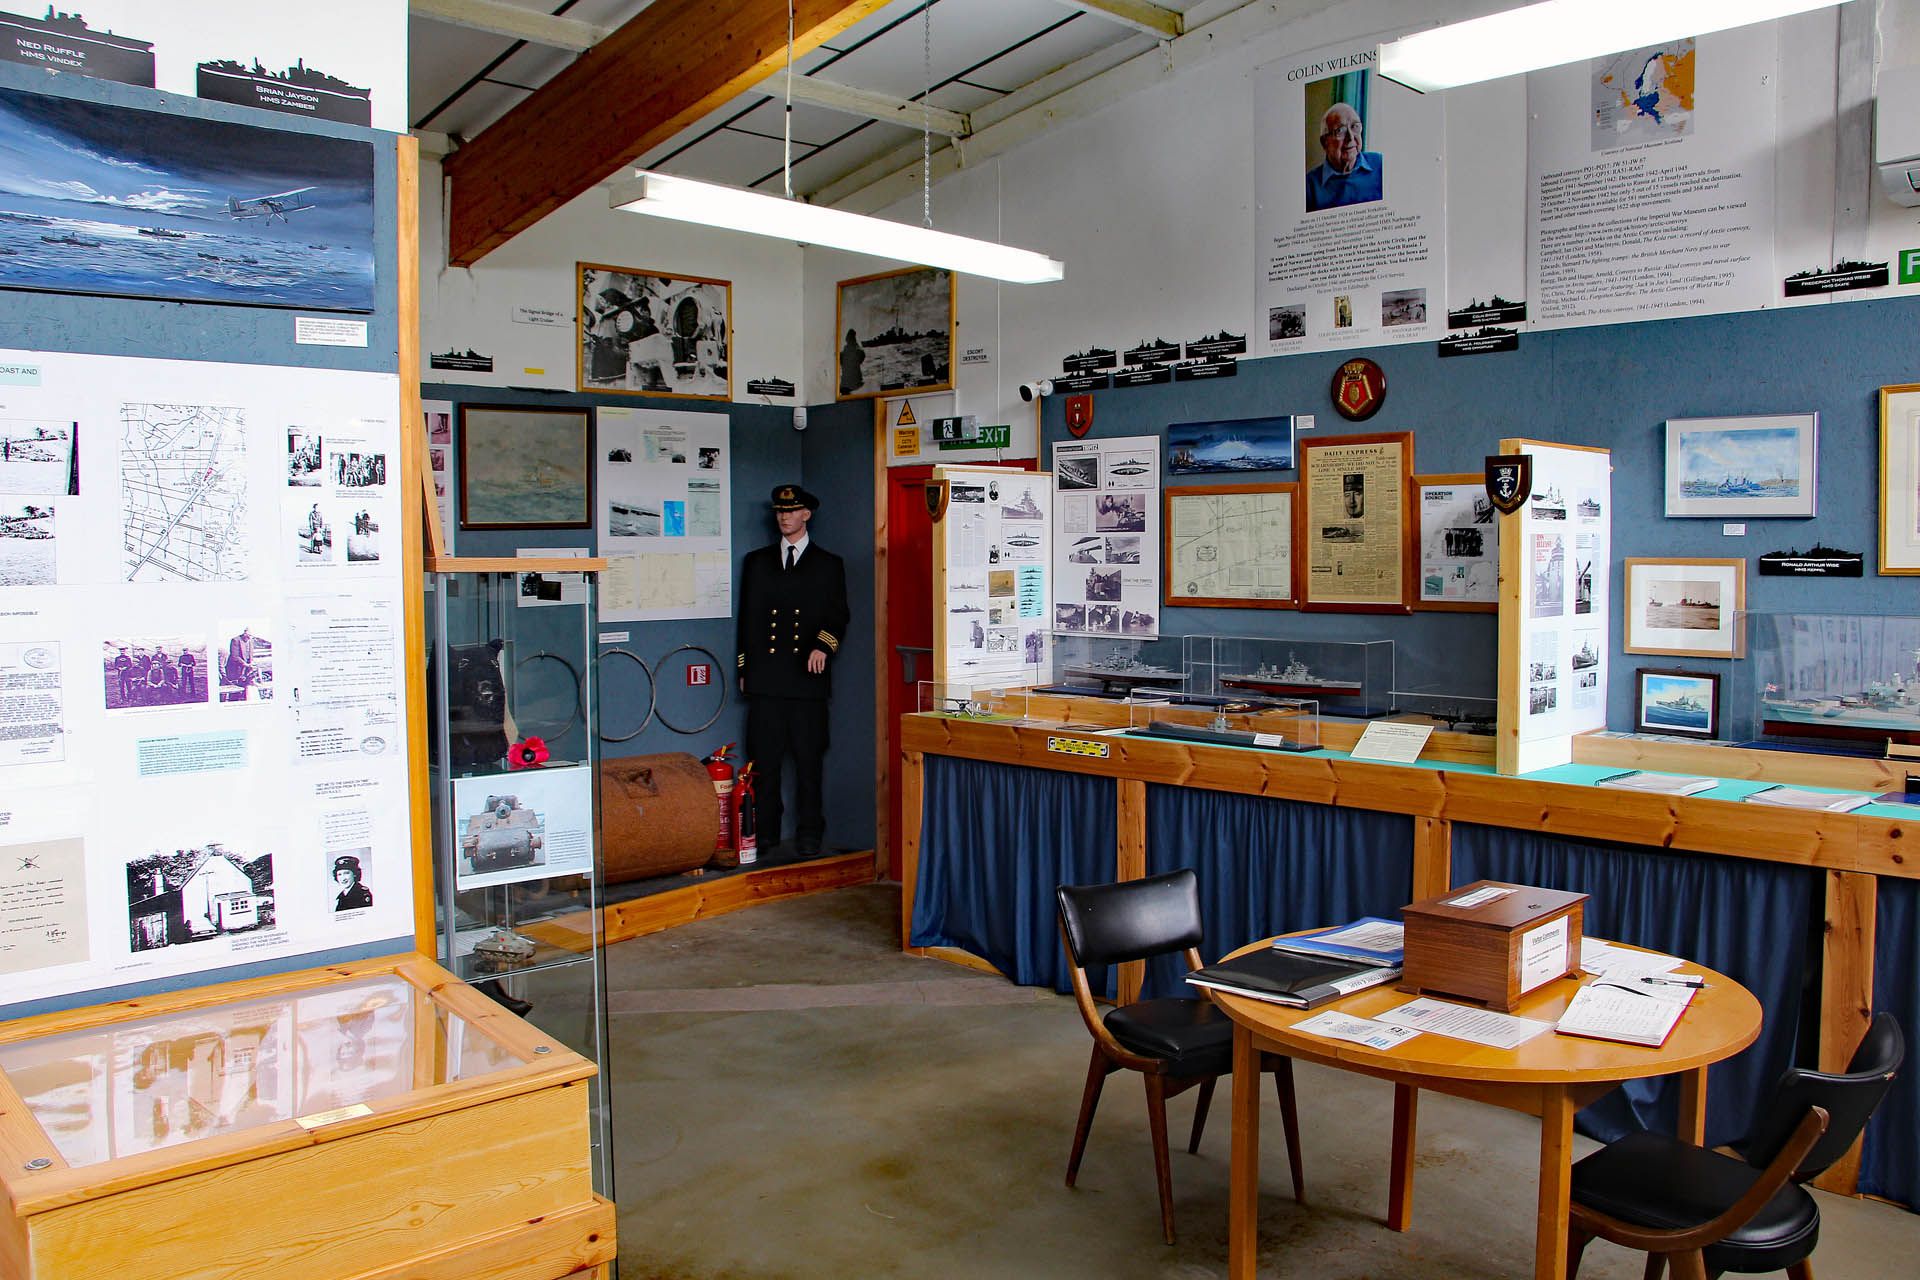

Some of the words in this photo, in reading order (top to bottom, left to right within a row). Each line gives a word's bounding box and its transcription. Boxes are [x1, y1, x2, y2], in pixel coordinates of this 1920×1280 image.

[17, 39, 41, 50] NED
[44, 44, 86, 59] RUFFLE
[20, 50, 45, 59] HMS
[47, 54, 82, 67] VINDEX
[1288, 63, 1324, 81] COLIN
[256, 85, 284, 97] BRIAN
[285, 92, 319, 103] JAYSON
[260, 96, 281, 104] HMS
[1683, 207, 1706, 215] Museum
[22, 368, 38, 376] AND
[976, 427, 1007, 444] EXIT
